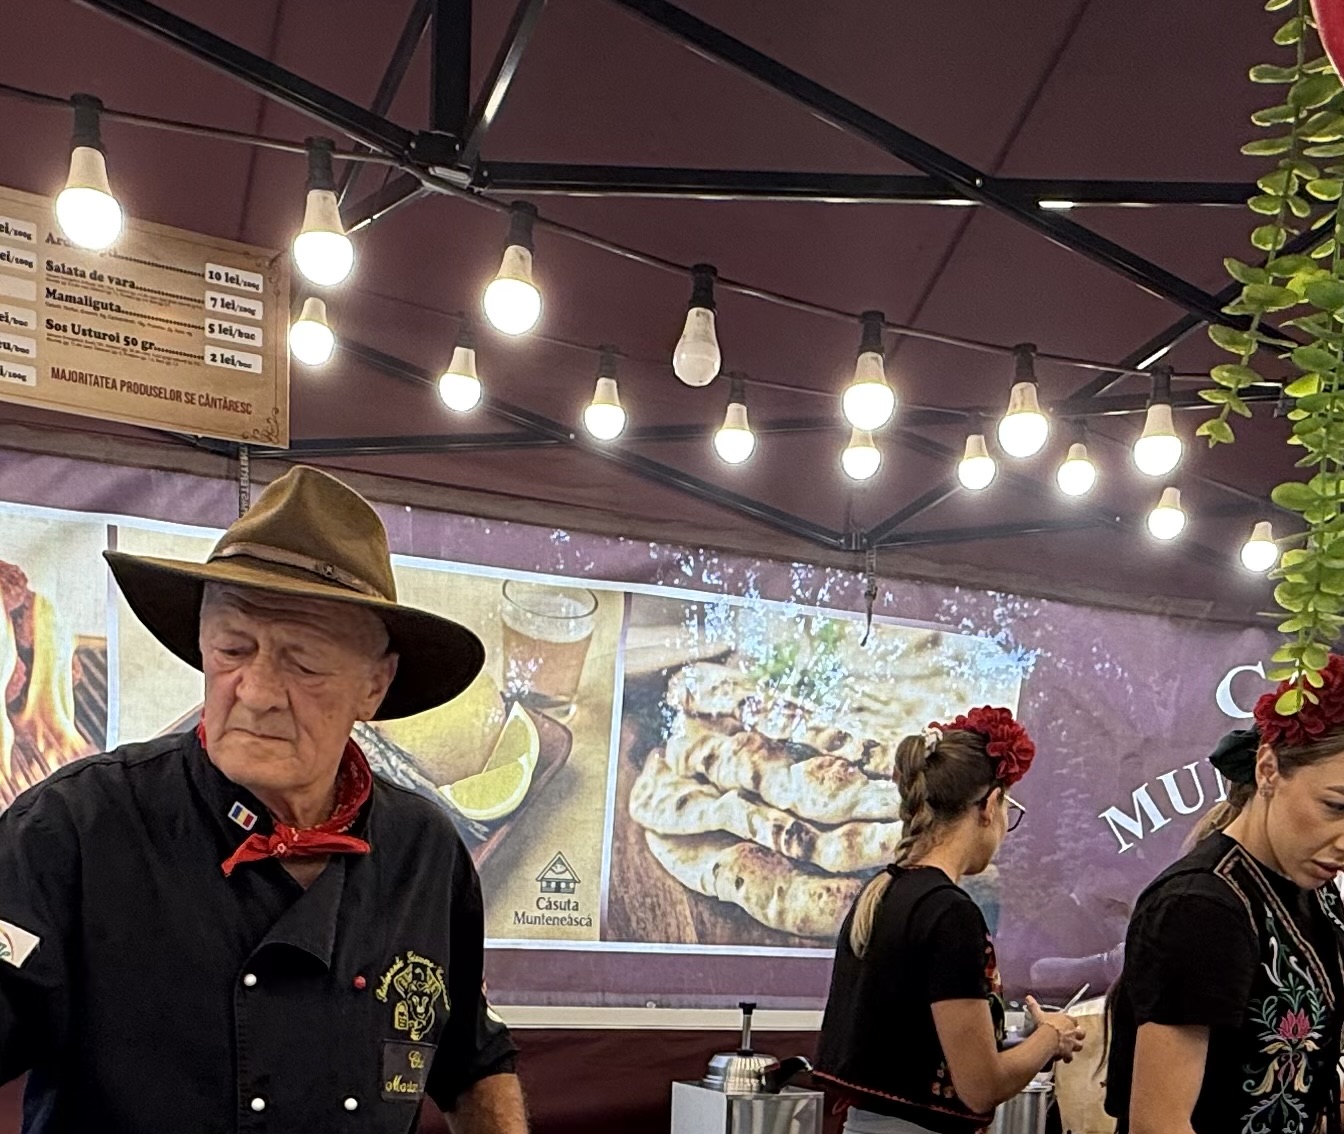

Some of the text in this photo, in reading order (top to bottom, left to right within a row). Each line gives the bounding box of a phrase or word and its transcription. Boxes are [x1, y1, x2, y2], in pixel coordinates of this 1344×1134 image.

[46, 260, 86, 281] Salata
[89, 269, 105, 283] de
[107, 275, 136, 290] vara
[209, 296, 218, 308] 7
[208, 269, 222, 282] 10
[45, 287, 122, 316] Mamaliguta
[207, 323, 216, 335] 5
[46, 318, 68, 334] Sos
[71, 322, 121, 345] Usturoi
[123, 335, 139, 349] 50
[209, 352, 218, 364] 2
[50, 366, 118, 392] MAJORITATEA
[120, 378, 183, 405] PRODUSELOR
[184, 392, 197, 407] SE
